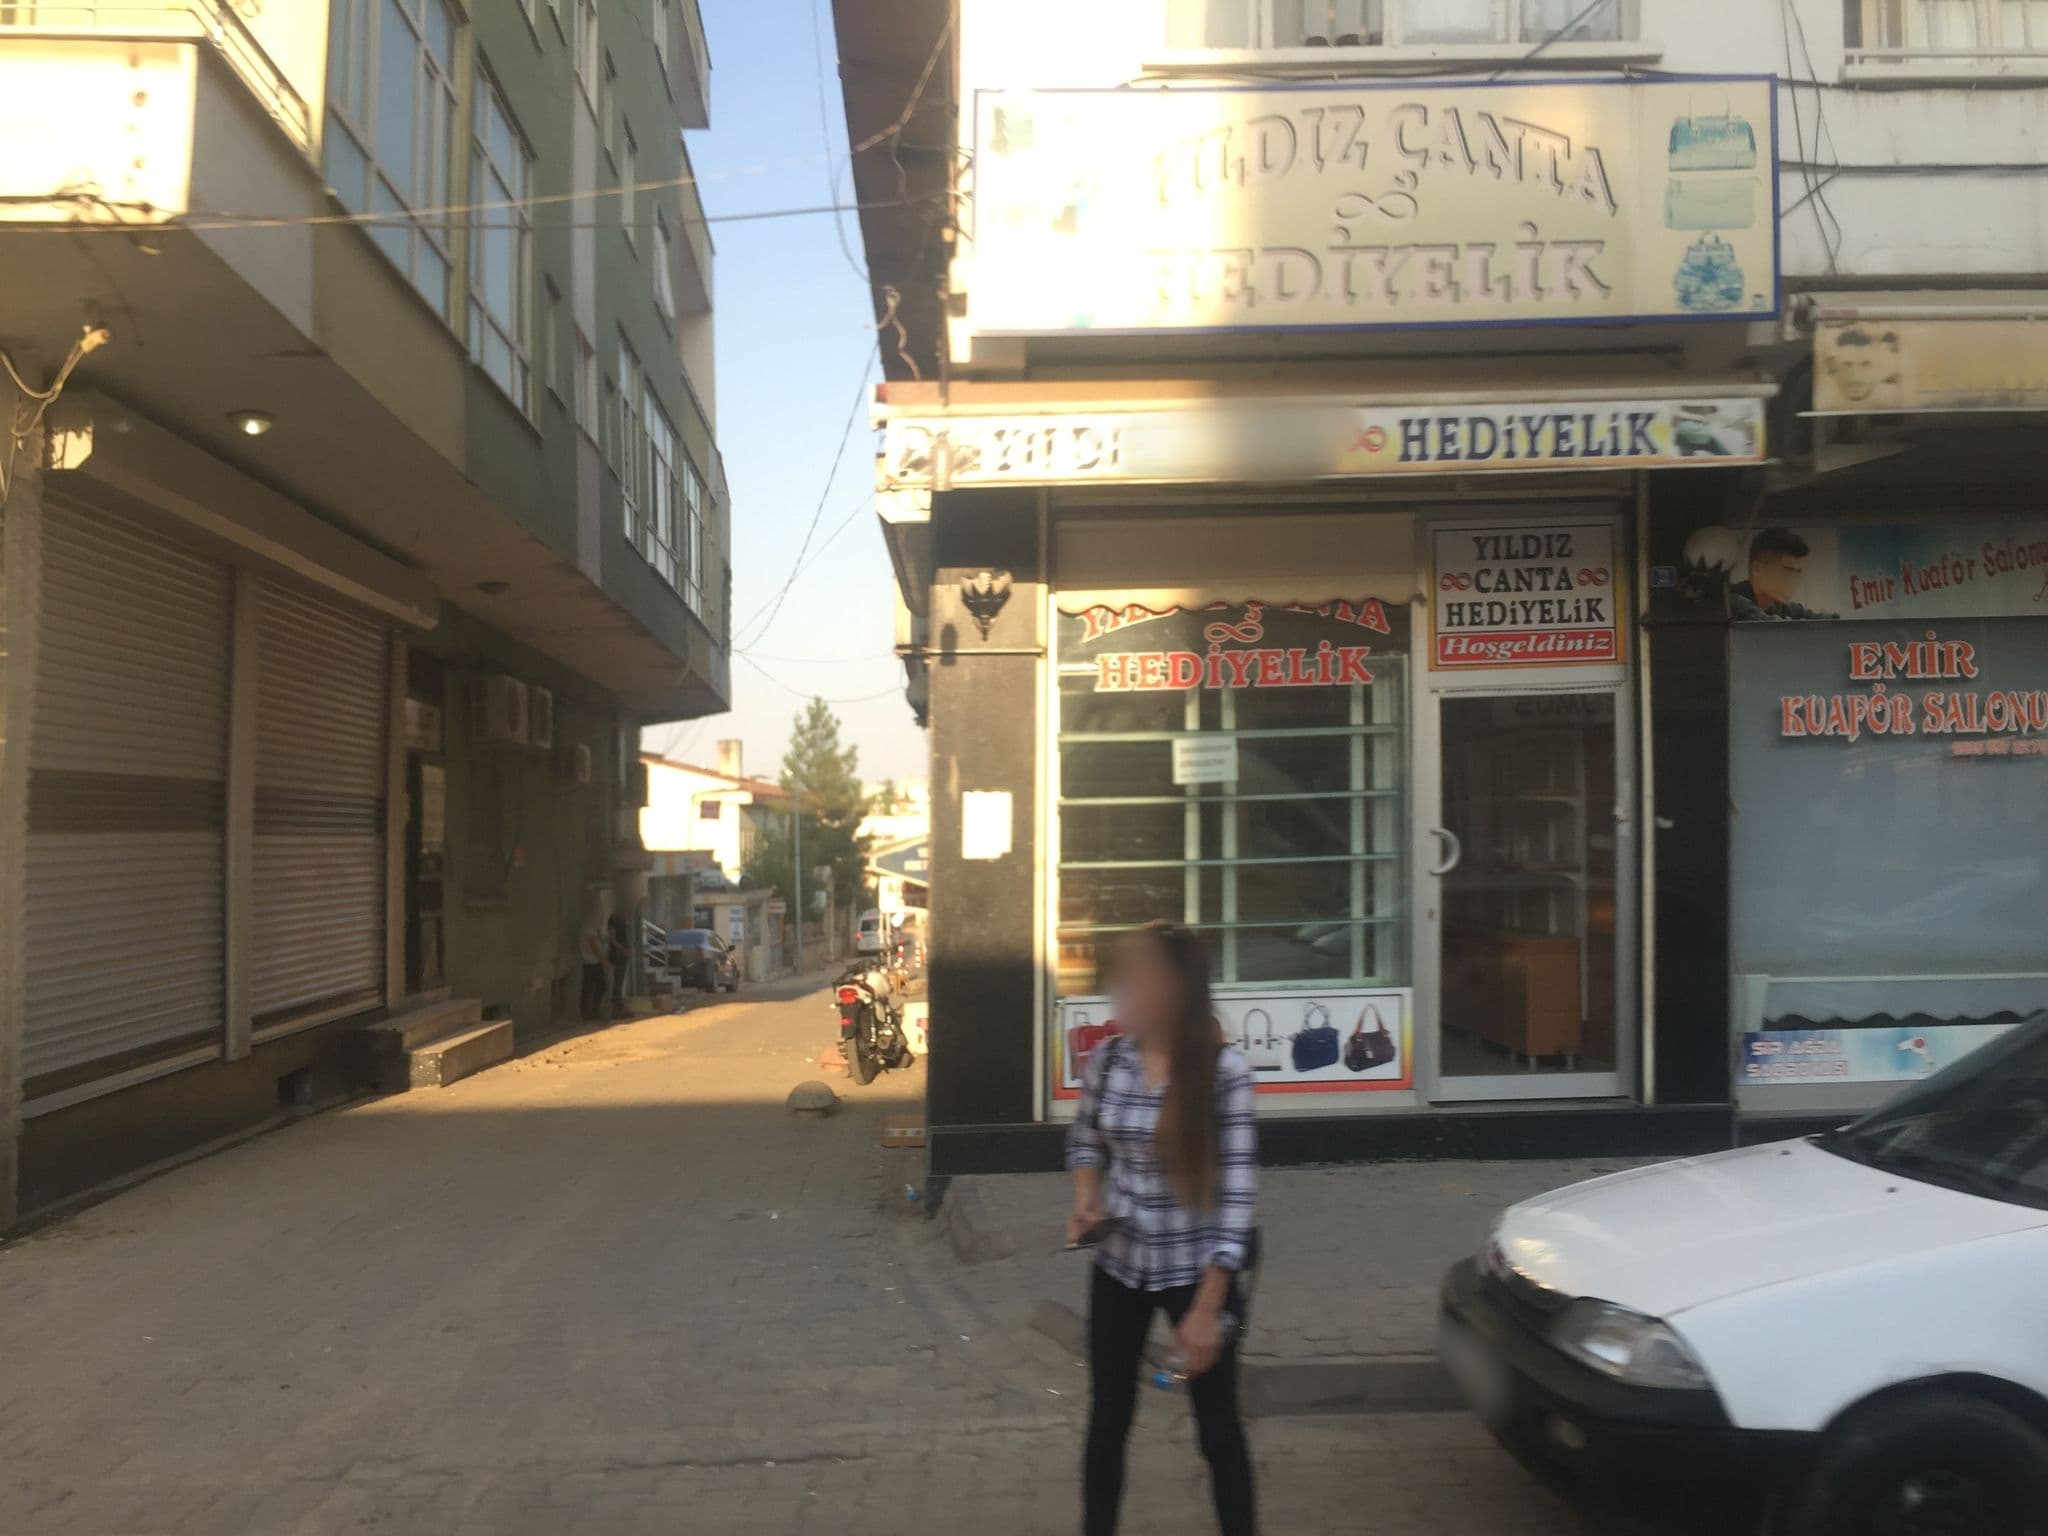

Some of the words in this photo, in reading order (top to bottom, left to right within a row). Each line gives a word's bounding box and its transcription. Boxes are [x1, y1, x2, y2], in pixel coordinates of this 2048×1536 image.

[1388, 103, 1618, 216] ÇANTA
[1472, 532, 1574, 561] YILDIZ
[1474, 566, 1574, 594] CANTA
[1850, 570, 1895, 610] Emir
[1094, 640, 1375, 692] HEDİYELİK
[1444, 632, 1610, 659] Hoşgeldiniz
[1849, 630, 1979, 680] EMİR
[1782, 682, 1916, 742] KUAFÖR
[1922, 690, 2048, 735] SALONU
